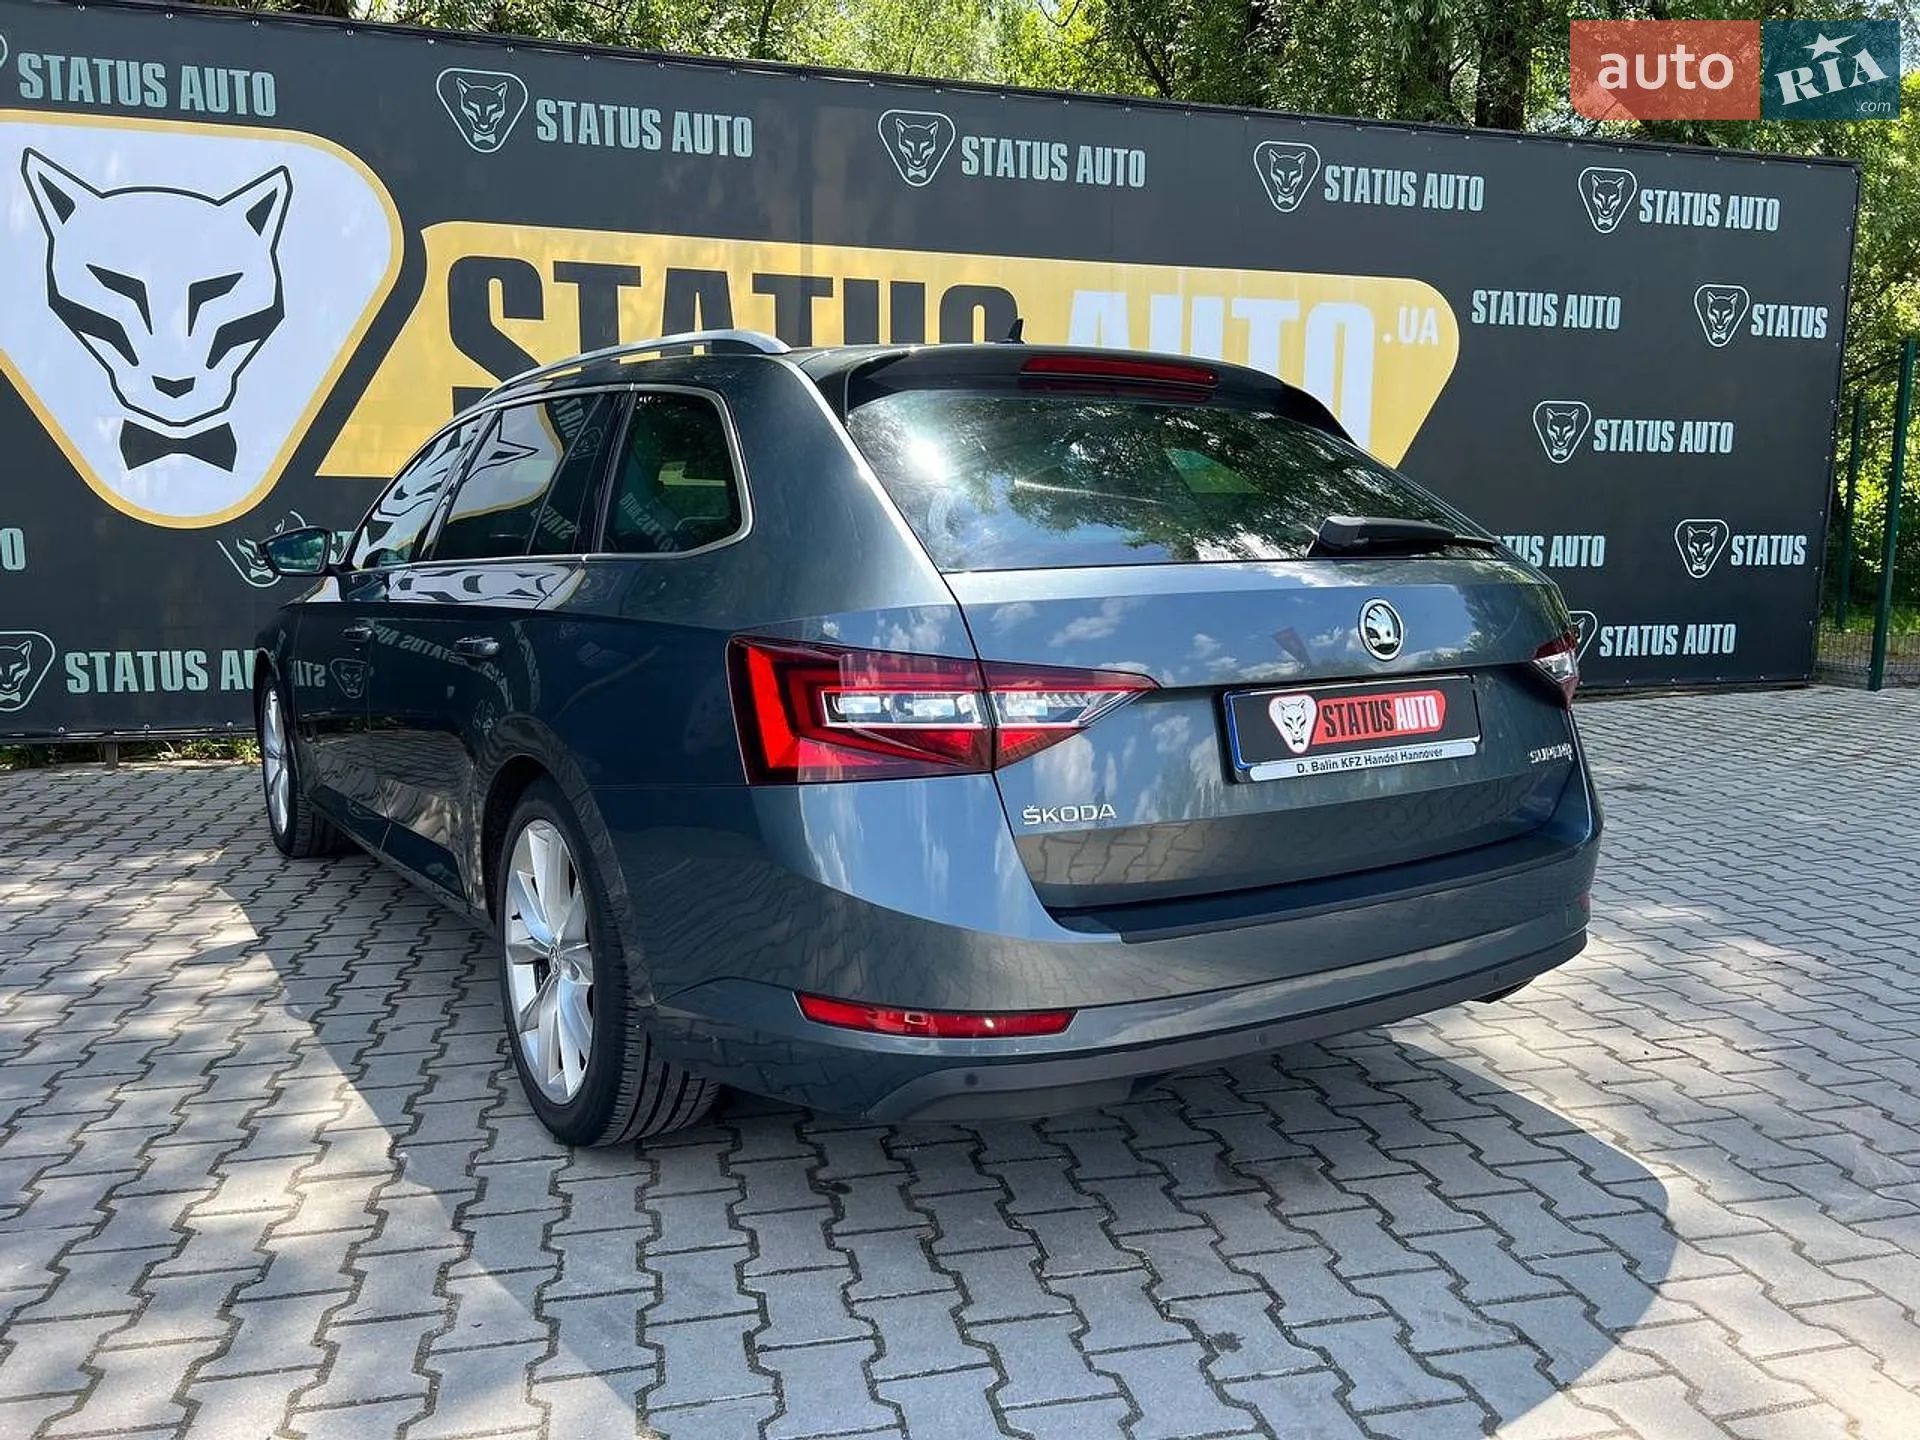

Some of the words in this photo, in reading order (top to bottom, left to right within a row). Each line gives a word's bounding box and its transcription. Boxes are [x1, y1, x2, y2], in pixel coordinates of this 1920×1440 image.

[17, 52, 168, 108] STATUS
[179, 65, 276, 117] AUTO
[536, 98, 662, 151] STATUS
[671, 110, 753, 158] AUTO
[960, 136, 1068, 183] STATUS
[1075, 145, 1146, 188] AUTO
[1324, 165, 1417, 208] STATUS
[1422, 172, 1485, 212] AUTO
[1638, 188, 1721, 229] STATUS
[1724, 195, 1780, 232] AUTO
[1471, 289, 1558, 328] STATUS
[1562, 294, 1622, 331] AUTO
[1750, 303, 1829, 339] STATUS
[1593, 418, 1675, 454] STATUS
[1678, 421, 1734, 454] AUTO
[1548, 535, 1606, 568] AUTO
[1731, 534, 1807, 567] STATUS
[1599, 624, 1679, 657] STATUS
[1682, 622, 1737, 656] AUTO
[64, 650, 209, 694] STATUS
[1321, 699, 1395, 738] STATUS
[1394, 695, 1440, 731] AUTO
[1296, 763, 1309, 775] D.
[1311, 758, 1339, 773] Balin
[1341, 755, 1362, 769] KFZ
[1364, 750, 1400, 766] Handel
[1401, 747, 1443, 762] Hannover
[1022, 804, 1117, 825] ŠKODA
